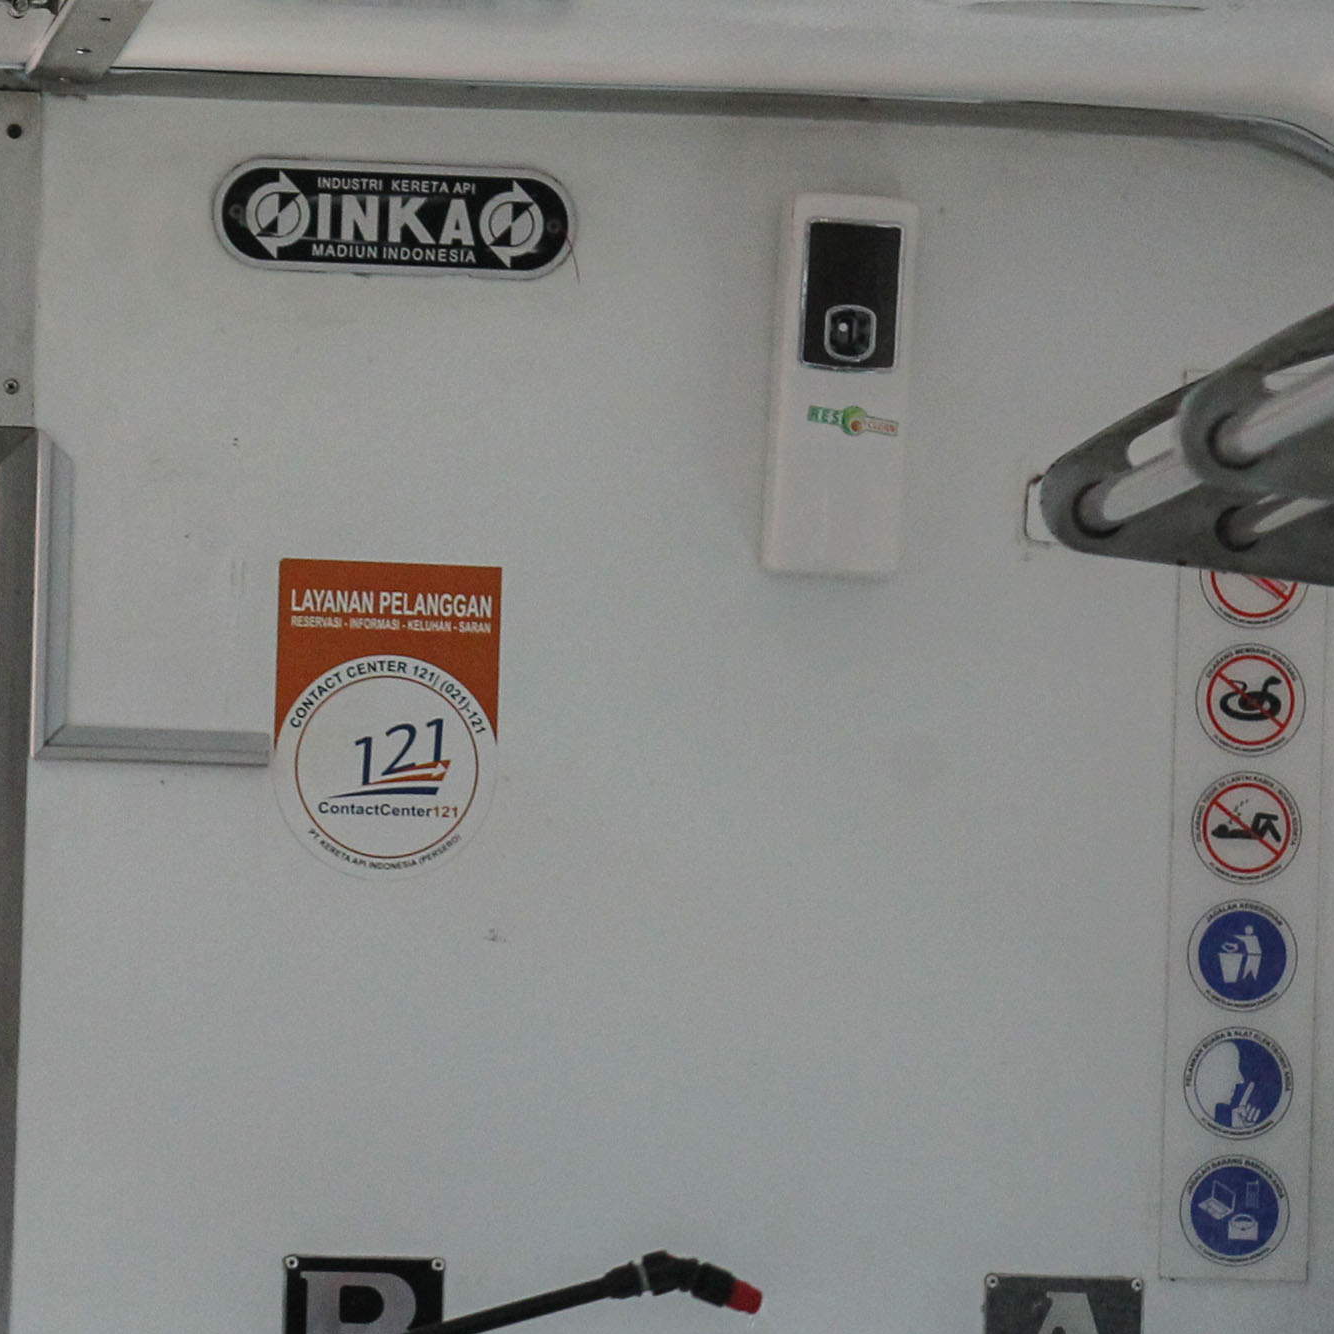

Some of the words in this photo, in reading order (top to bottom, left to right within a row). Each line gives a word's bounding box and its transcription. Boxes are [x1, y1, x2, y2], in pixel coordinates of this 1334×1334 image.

[317, 177, 383, 192] INDUSTRI
[391, 179, 448, 194] KERETA
[453, 181, 476, 195] API
[317, 193, 475, 246] INKA
[312, 244, 377, 260] MADIUN
[383, 247, 476, 264] INDONESIA
[291, 589, 375, 614] LAYANAN
[379, 592, 493, 618] PELANGGAN
[291, 615, 342, 628] RESERVASI
[349, 617, 400, 630] INFORMASI
[408, 619, 452, 632] KELUHAN
[458, 621, 492, 634] SARAN
[290, 672, 343, 729] CONTACT
[346, 660, 407, 678] CENTER
[439, 680, 486, 734] (021)-121
[355, 718, 444, 786] 121
[318, 802, 458, 818] ContactCenter121
